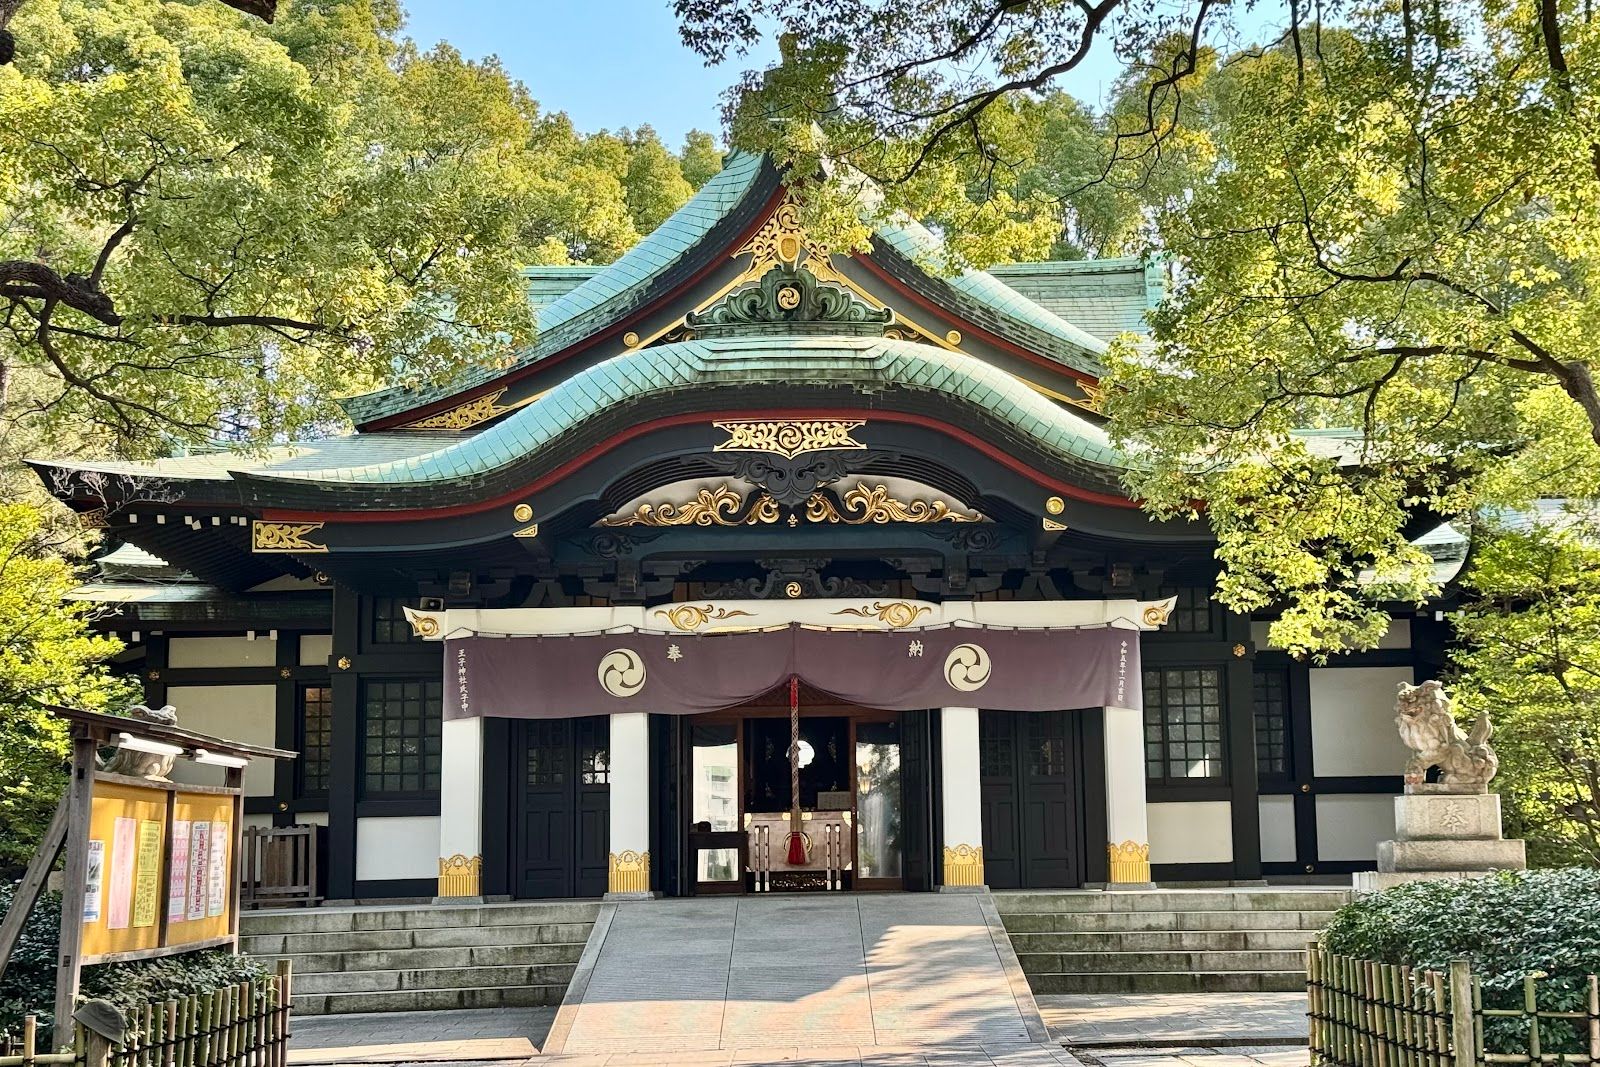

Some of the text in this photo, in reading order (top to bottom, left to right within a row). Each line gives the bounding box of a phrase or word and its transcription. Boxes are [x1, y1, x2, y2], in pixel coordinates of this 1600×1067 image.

[667, 640, 923, 662] 奉 納
[1118, 640, 1128, 701] 令和五年十一月吉日
[458, 649, 469, 712] 王子神社氏子中
[1440, 800, 1468, 833] 奉
